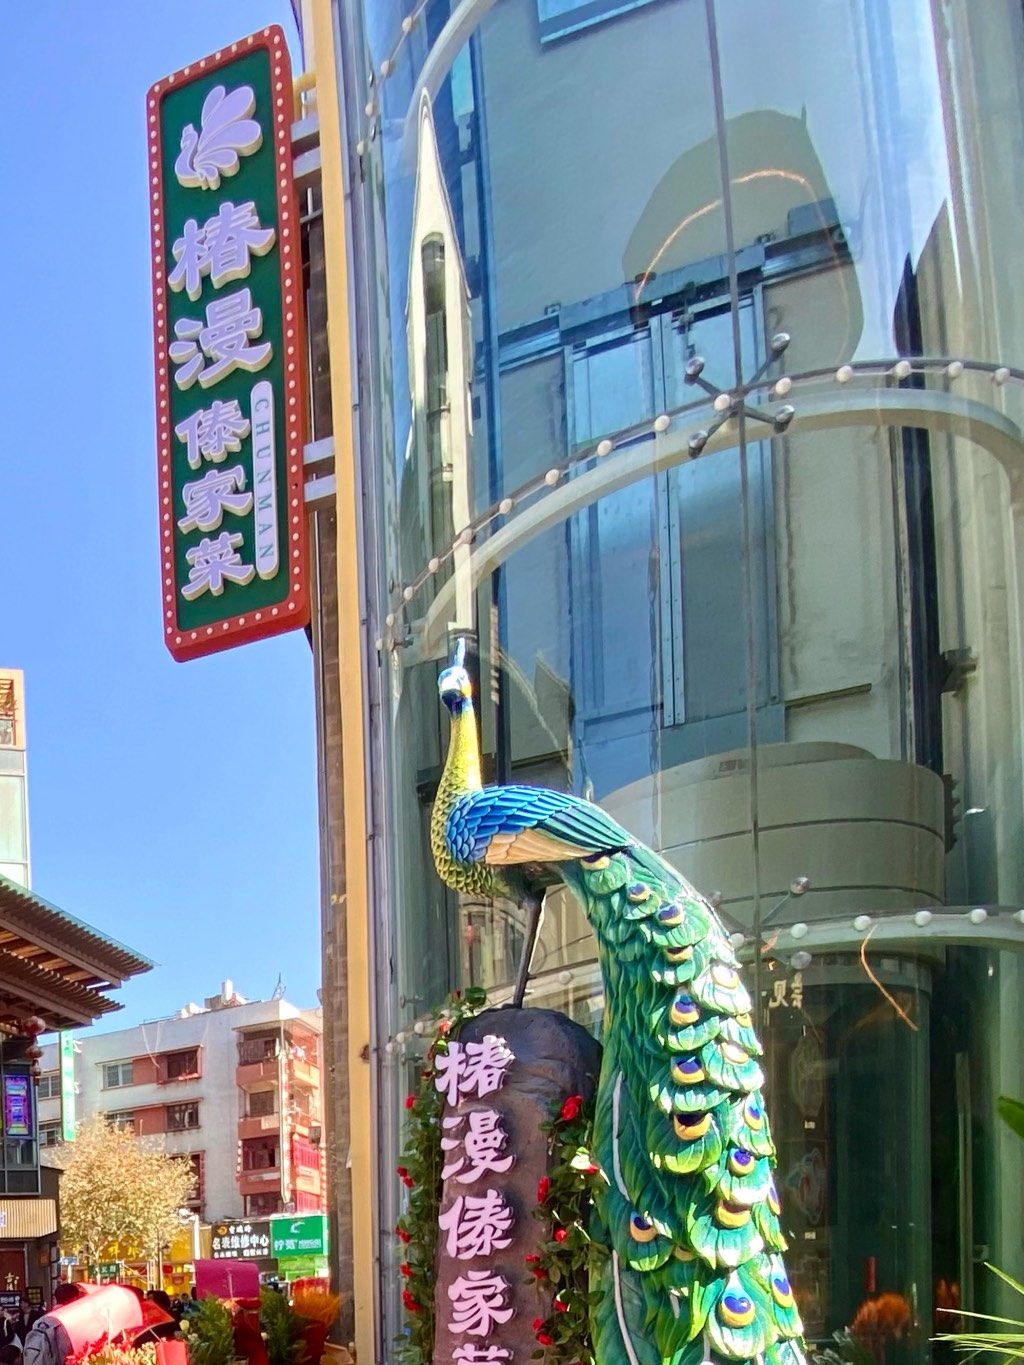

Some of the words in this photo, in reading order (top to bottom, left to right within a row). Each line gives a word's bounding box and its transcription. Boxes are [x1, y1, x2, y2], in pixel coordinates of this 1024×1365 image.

[168, 201, 276, 602] 椿漫傣家菜
[254, 397, 275, 561] CHUNMAN
